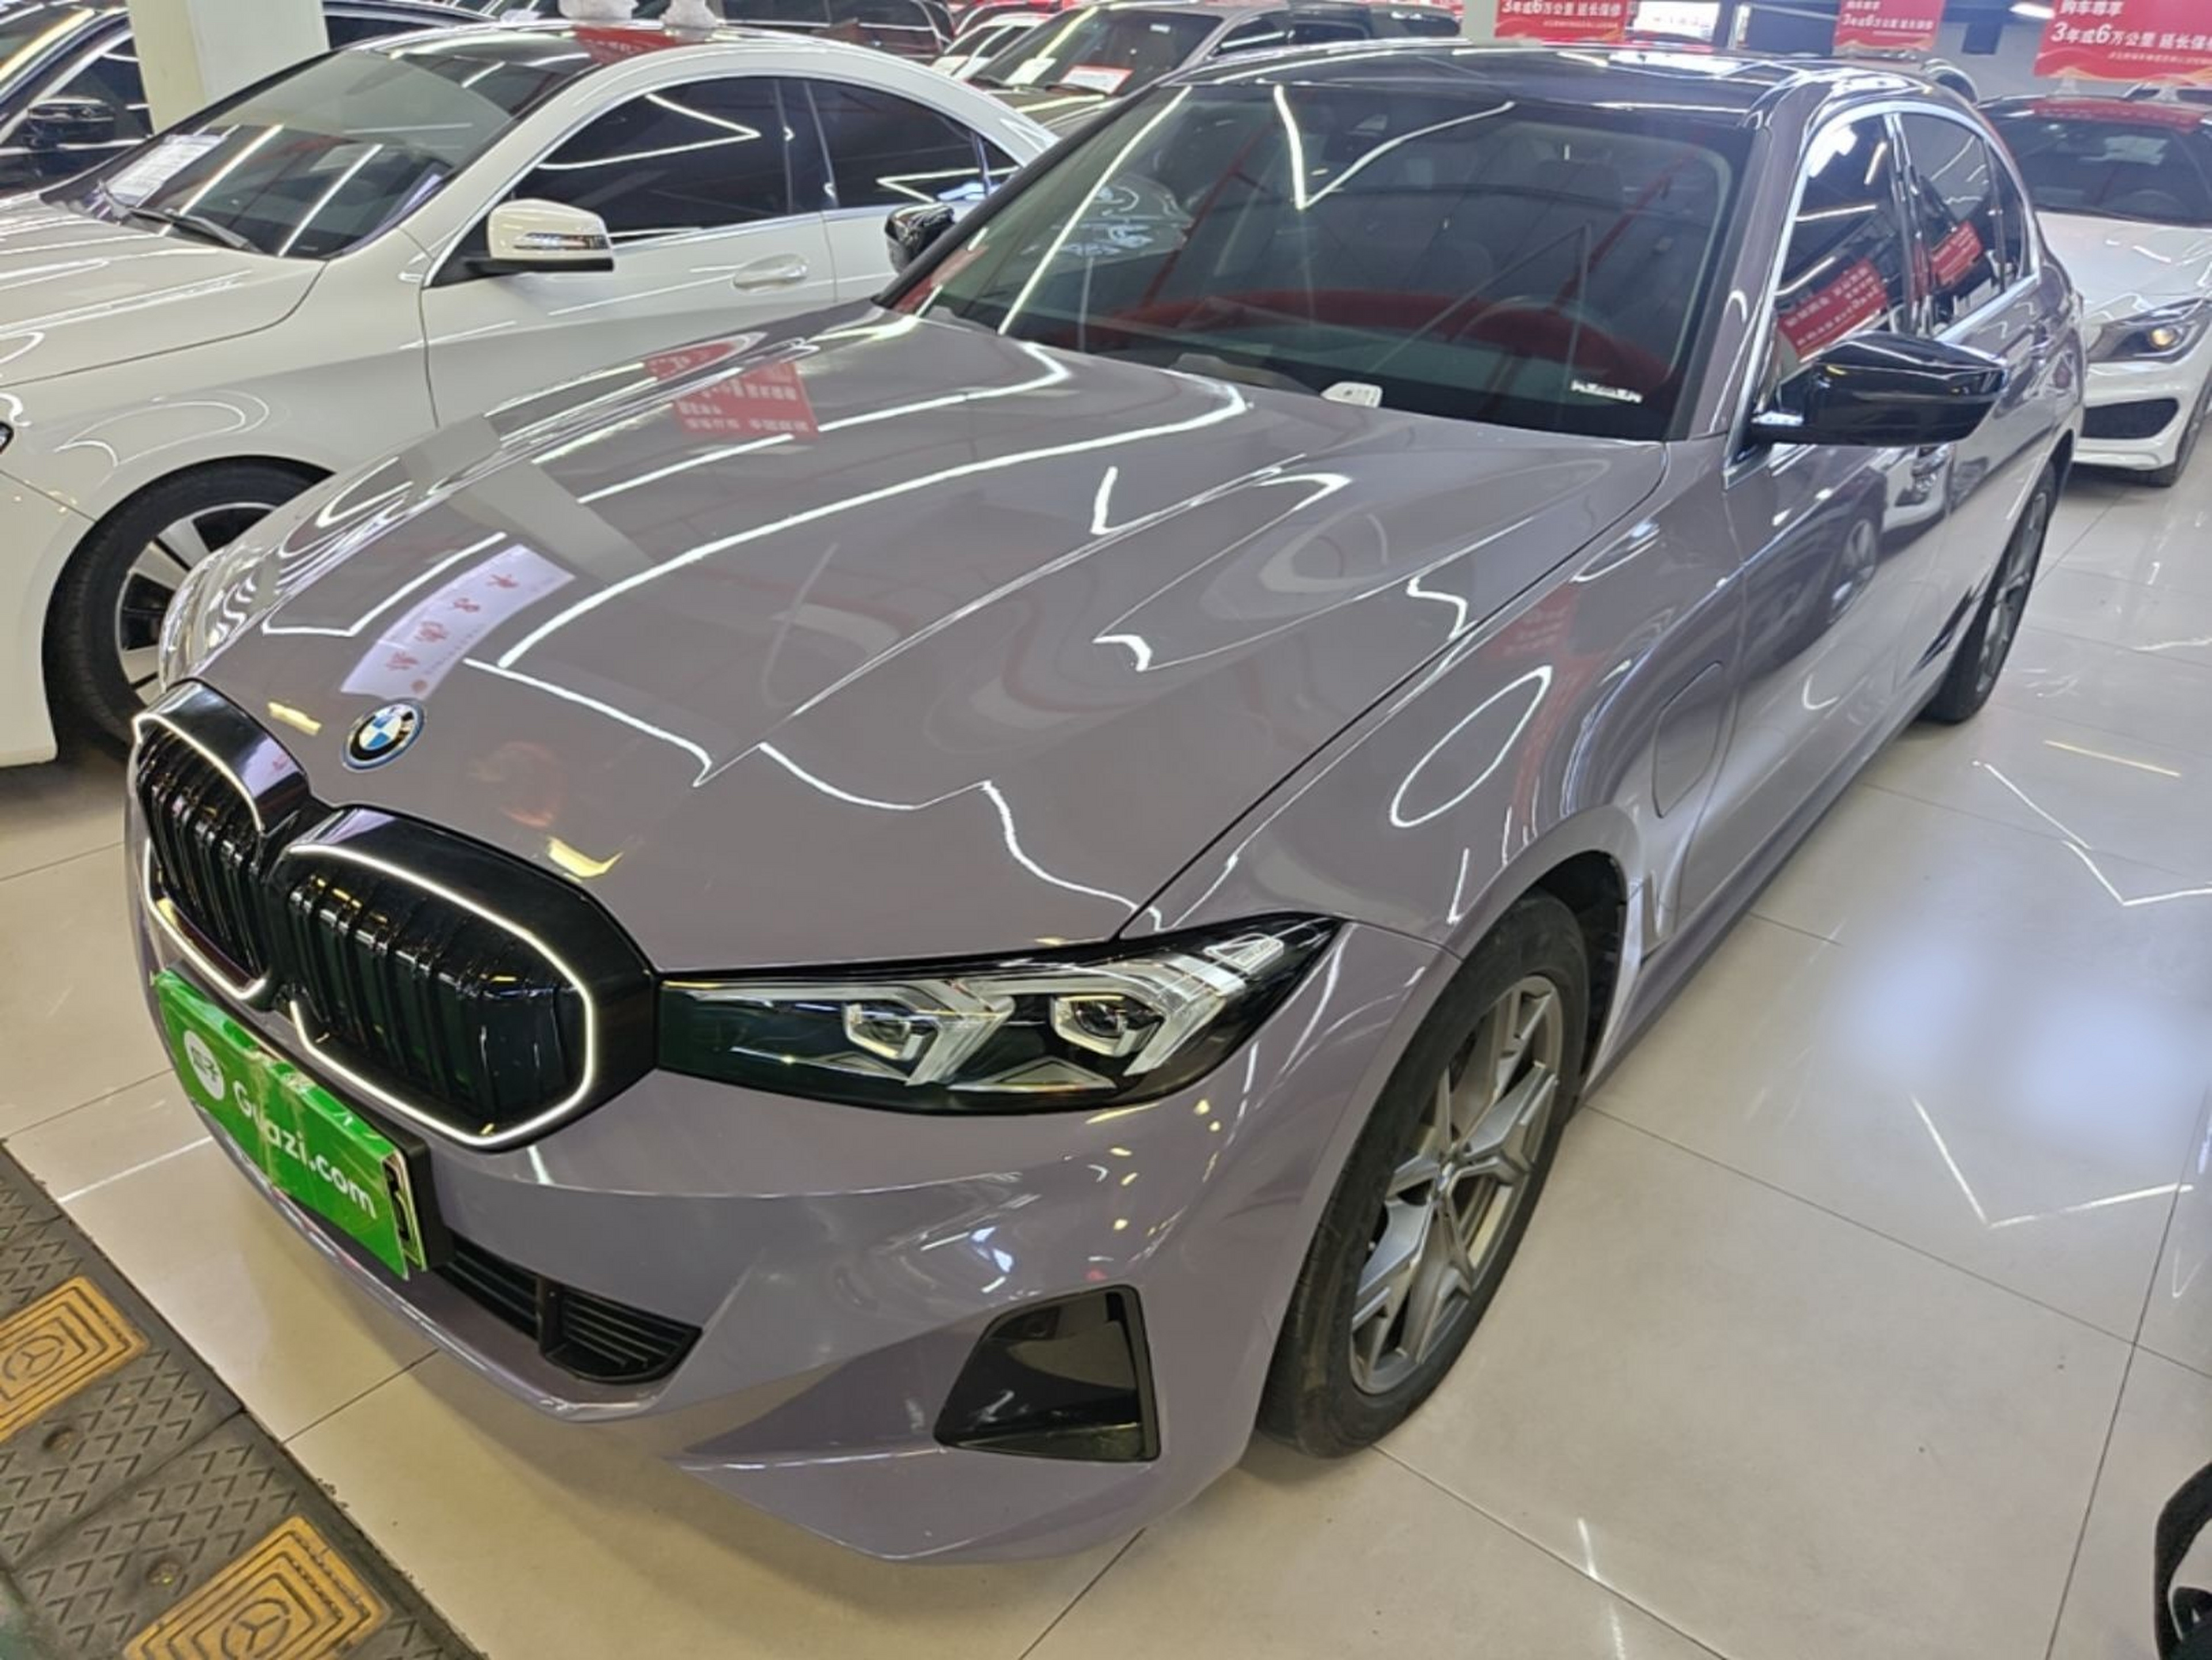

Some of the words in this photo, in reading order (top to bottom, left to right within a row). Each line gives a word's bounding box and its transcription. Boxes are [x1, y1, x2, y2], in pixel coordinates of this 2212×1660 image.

[2051, 22, 2156, 47] 3年或6万公里
